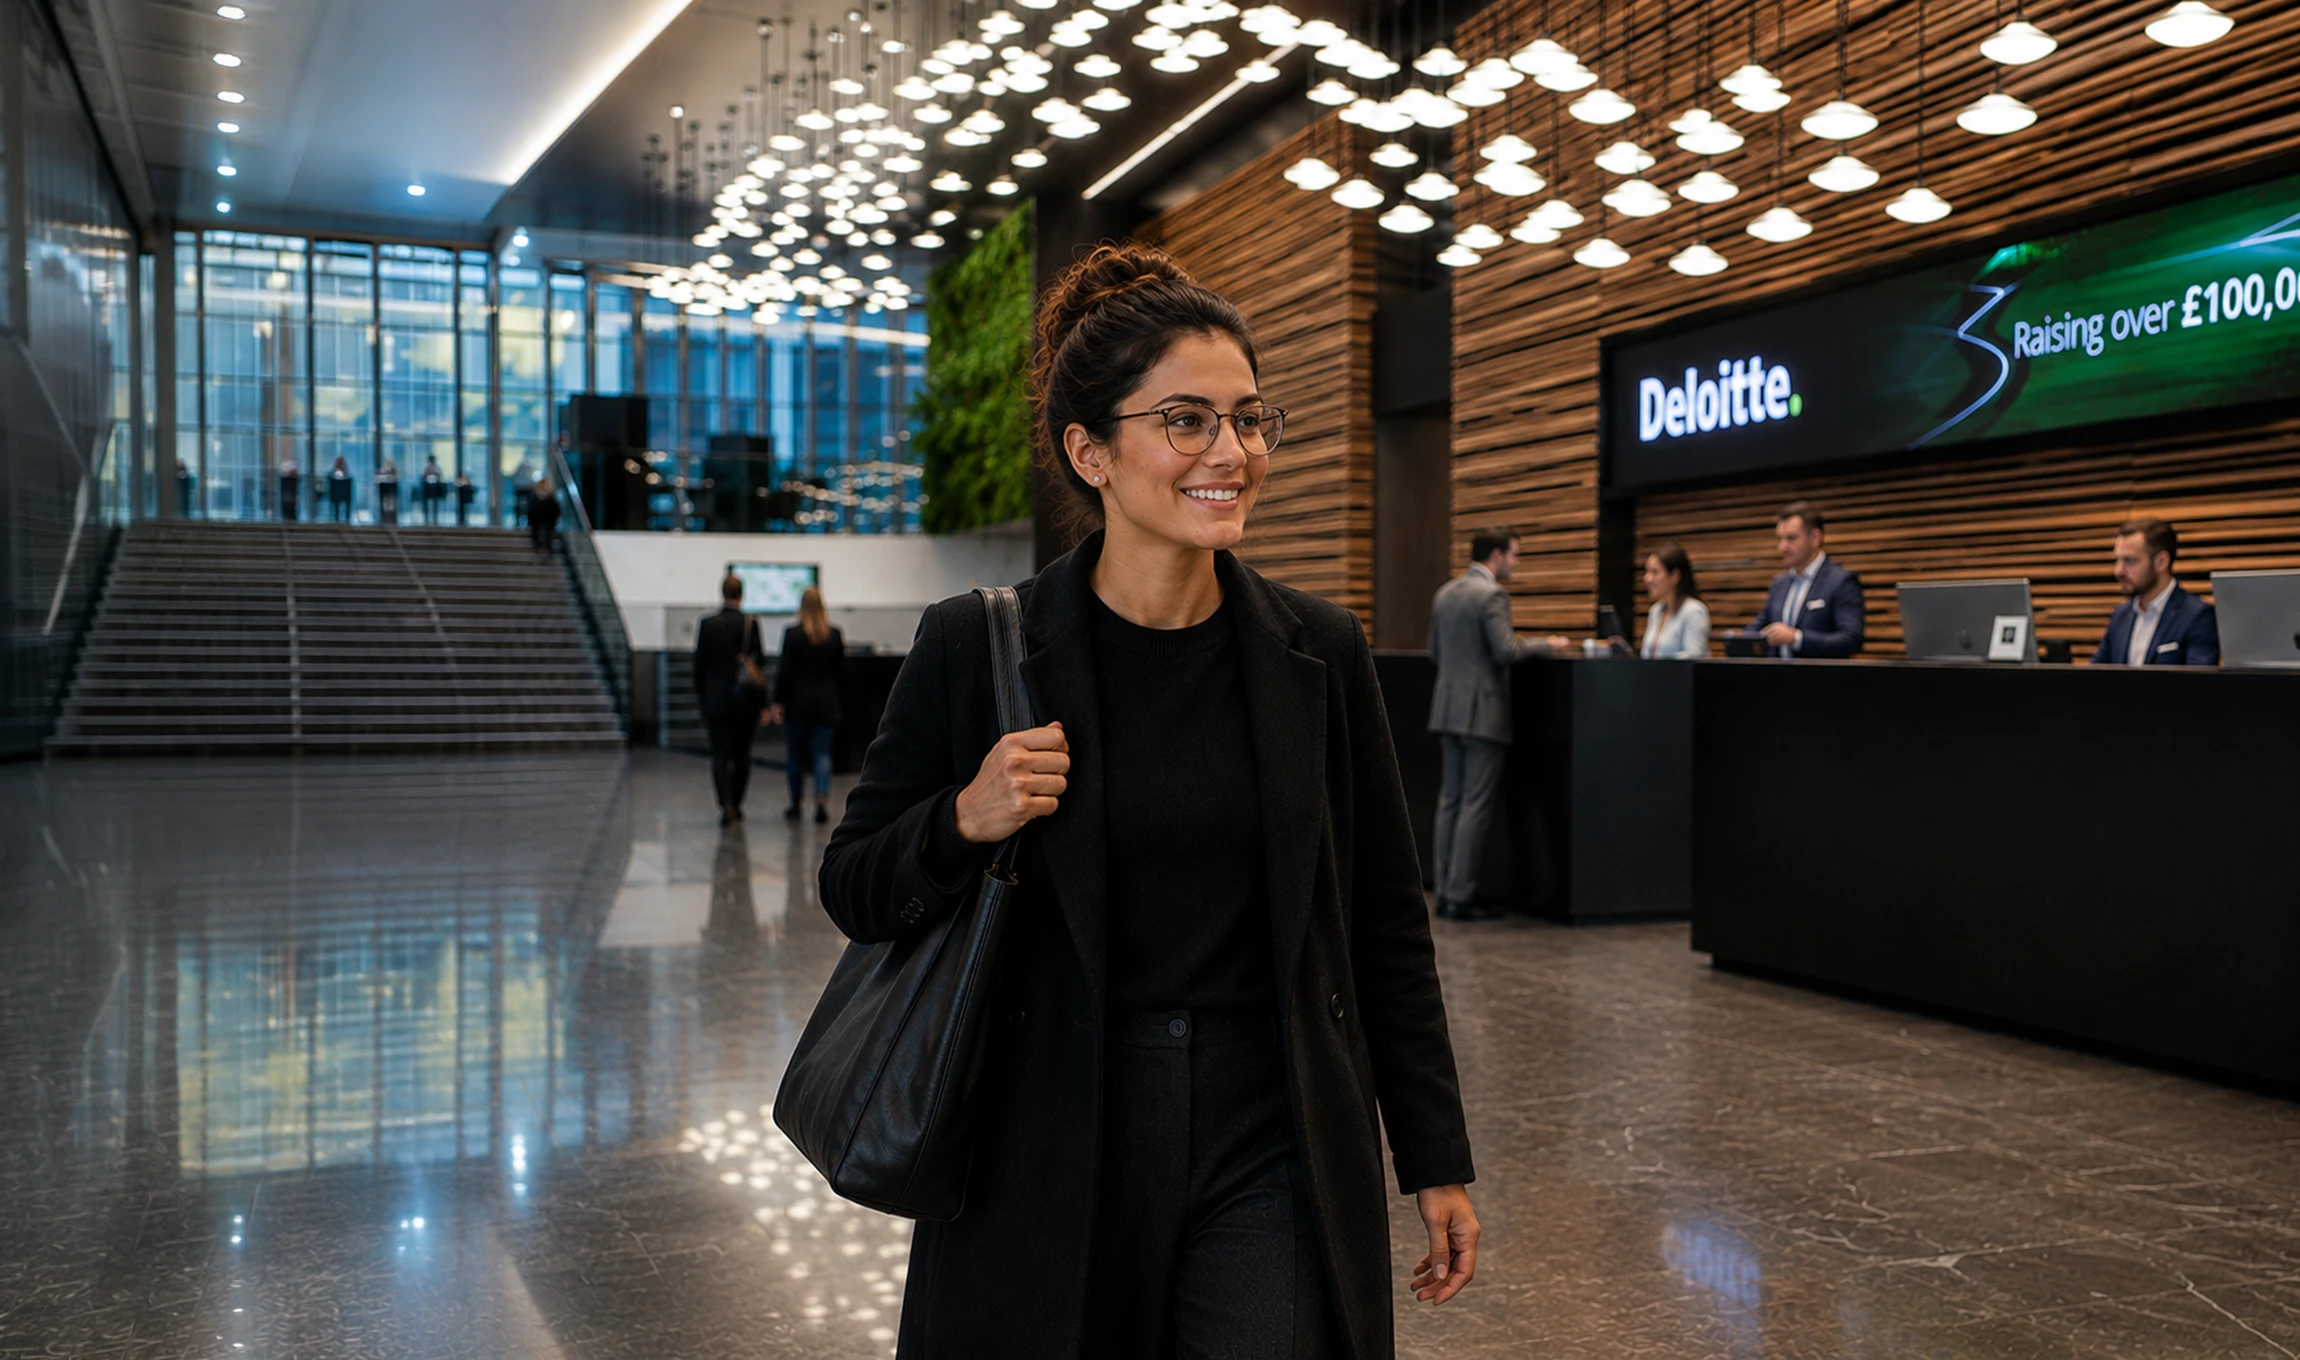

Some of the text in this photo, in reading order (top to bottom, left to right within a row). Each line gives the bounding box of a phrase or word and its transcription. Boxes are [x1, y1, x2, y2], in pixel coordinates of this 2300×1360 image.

[2014, 266, 2300, 358] Raising over £100,0
[1639, 355, 1803, 442] Deloitte.
